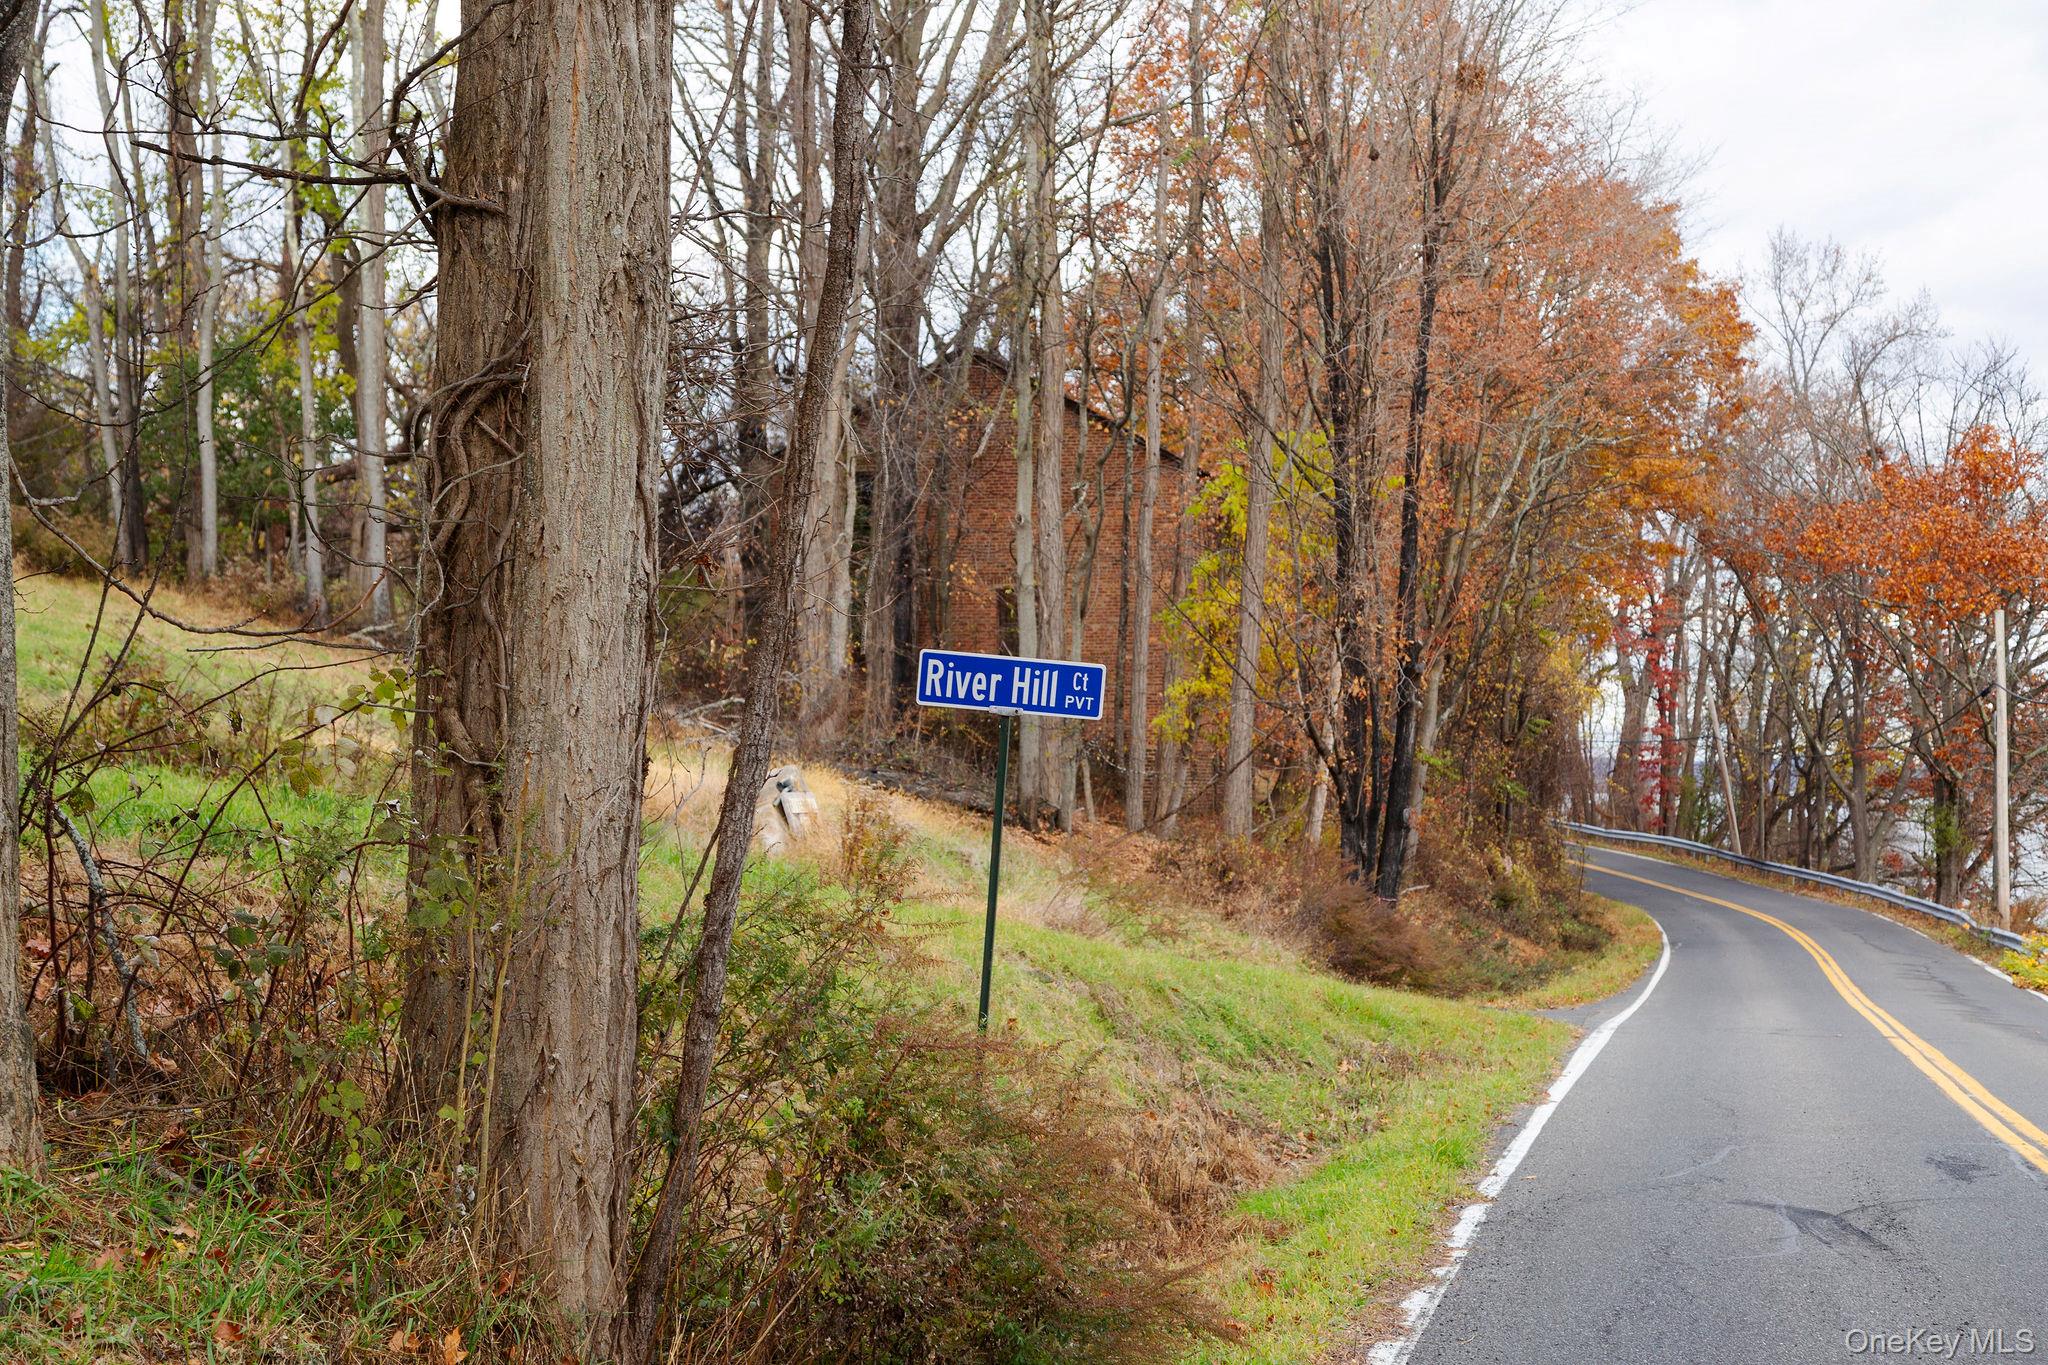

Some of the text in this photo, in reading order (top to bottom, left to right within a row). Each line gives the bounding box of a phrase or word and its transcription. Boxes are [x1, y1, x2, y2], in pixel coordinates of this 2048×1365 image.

[925, 658, 1089, 707] River Hill Ct
[1064, 695, 1095, 711] PVT
